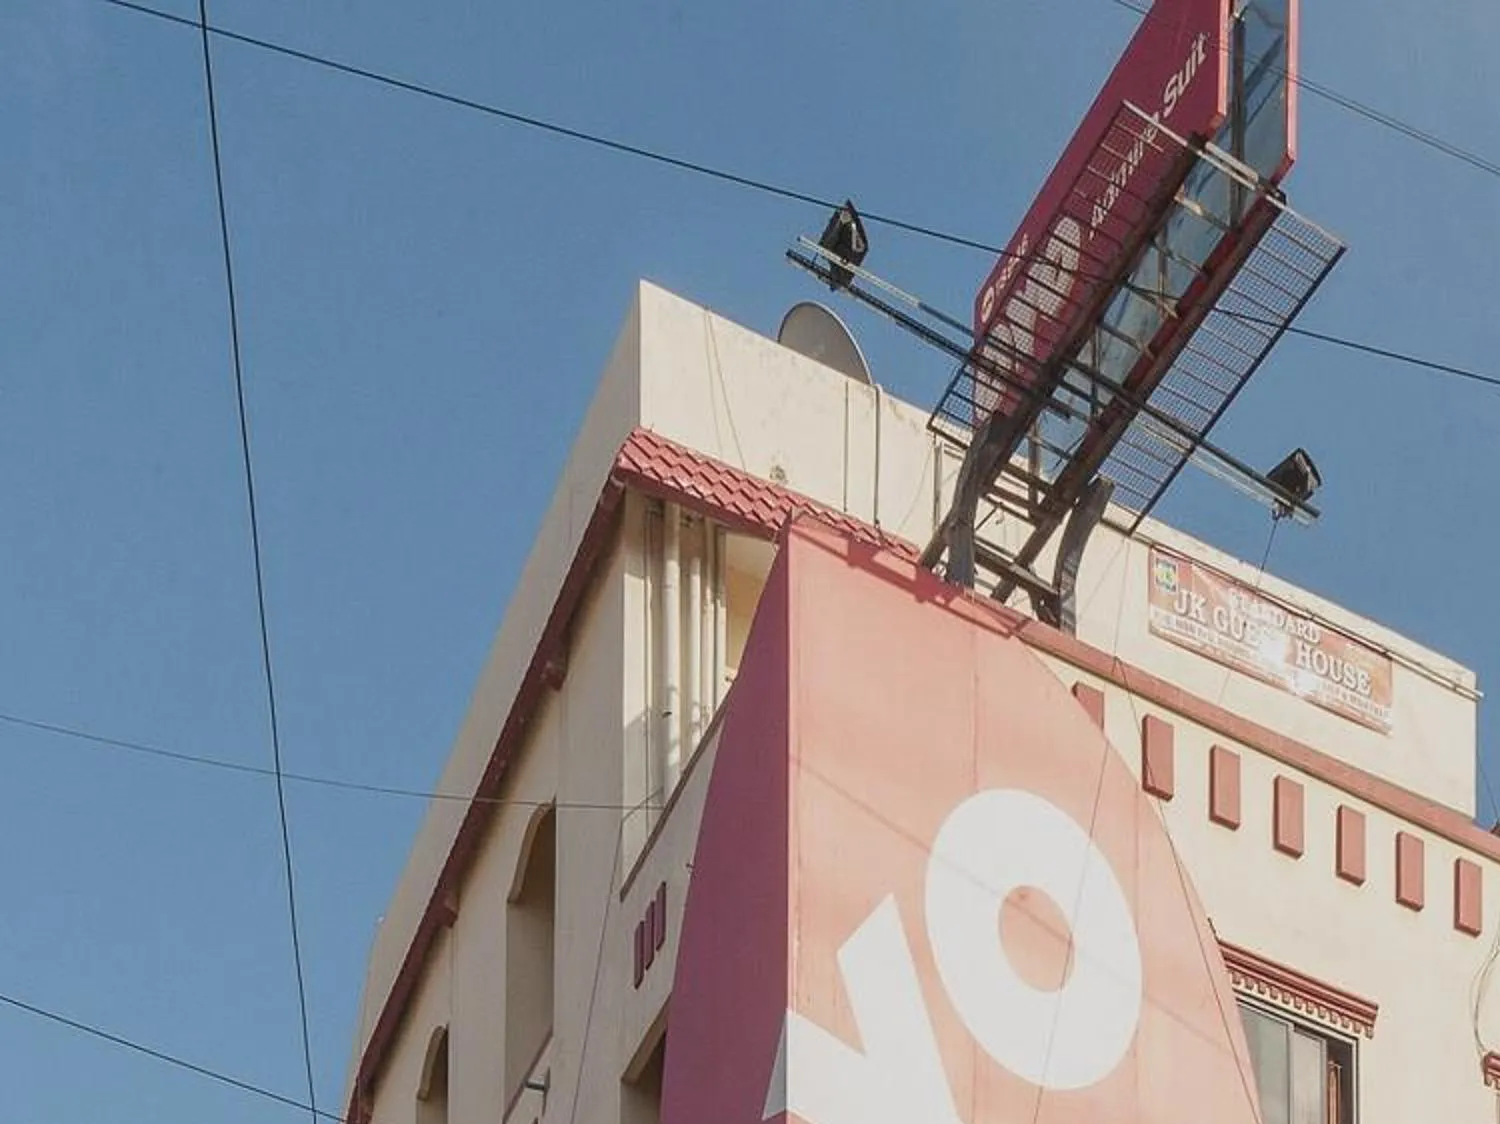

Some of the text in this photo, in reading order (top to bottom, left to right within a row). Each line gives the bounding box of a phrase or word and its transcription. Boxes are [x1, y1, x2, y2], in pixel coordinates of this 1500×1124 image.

[1162, 32, 1209, 118] Suit
[1173, 588, 1209, 626] JK
[1212, 603, 1279, 656] GUE
[1295, 640, 1371, 696] HOUSE
